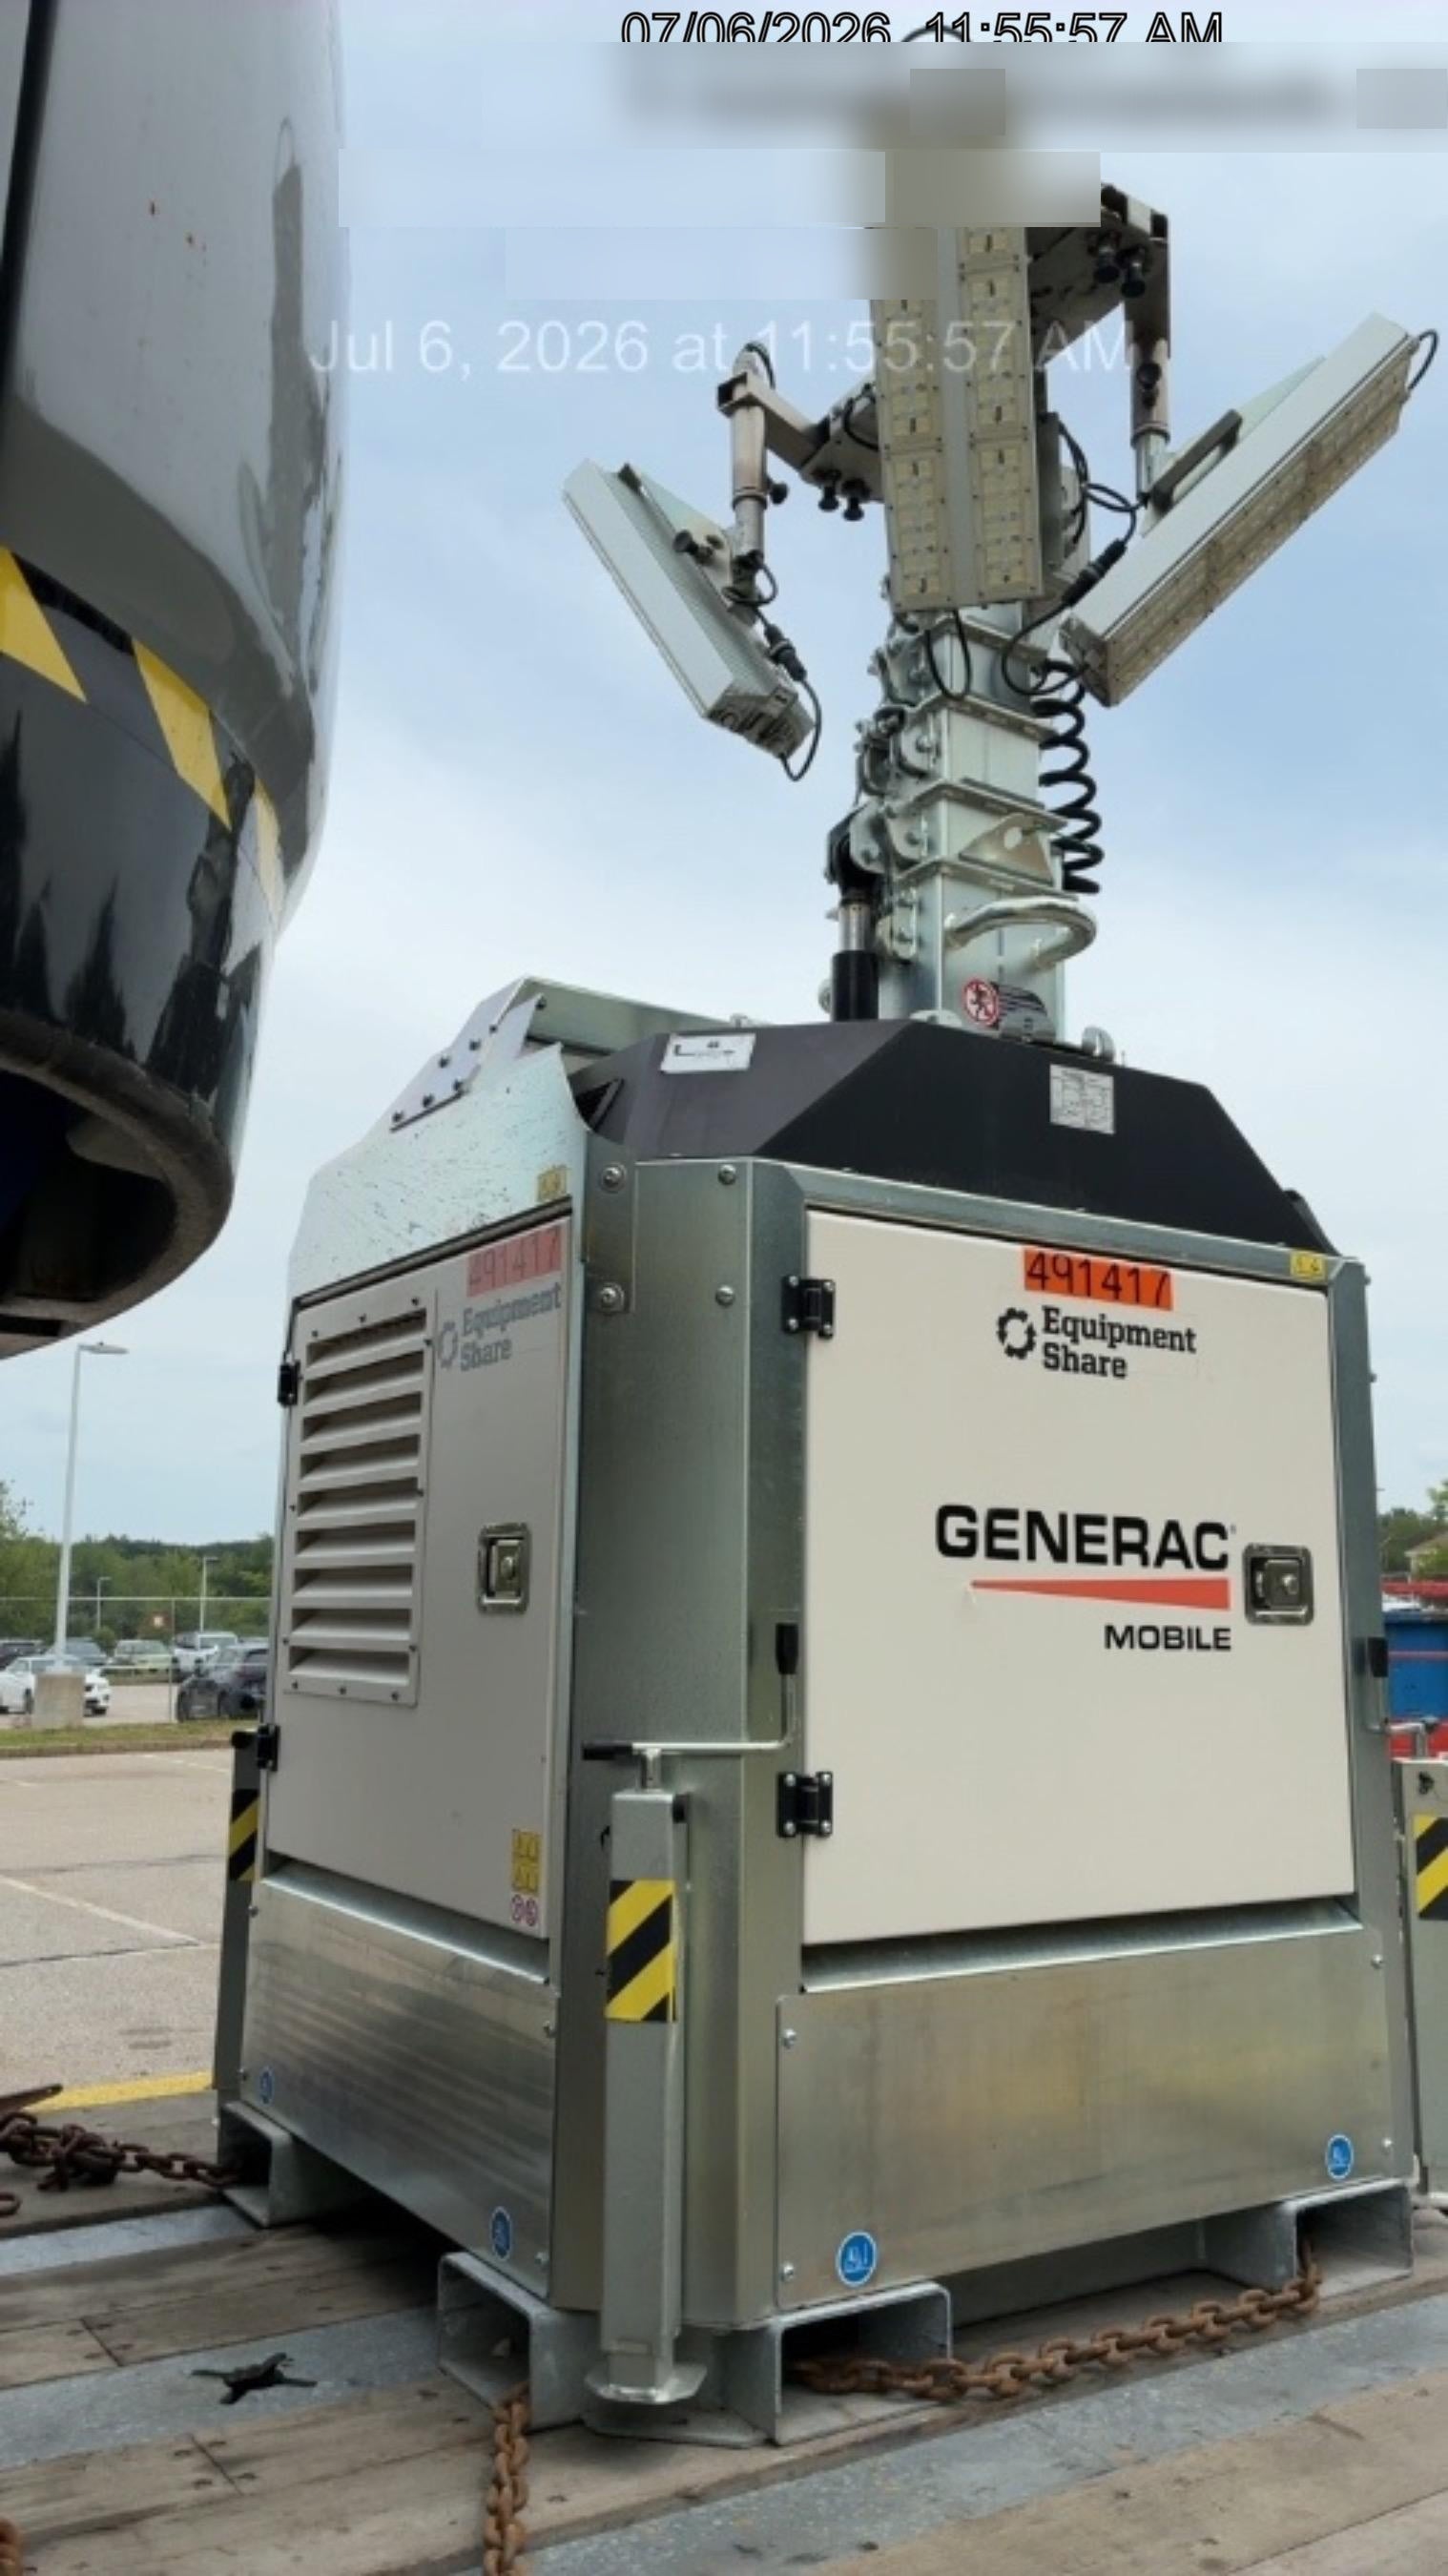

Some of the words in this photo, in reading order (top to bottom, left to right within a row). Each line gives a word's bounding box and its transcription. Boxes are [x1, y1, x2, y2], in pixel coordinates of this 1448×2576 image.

[1025, 1251, 1172, 1306] 491417
[462, 1281, 562, 1340] Equipment
[1042, 1304, 1197, 1354] Equipment
[460, 1339, 512, 1372] Share
[1043, 1341, 1127, 1379] Share
[936, 1504, 1230, 1570] GENERAC
[1104, 1624, 1231, 1652] MOBILE
